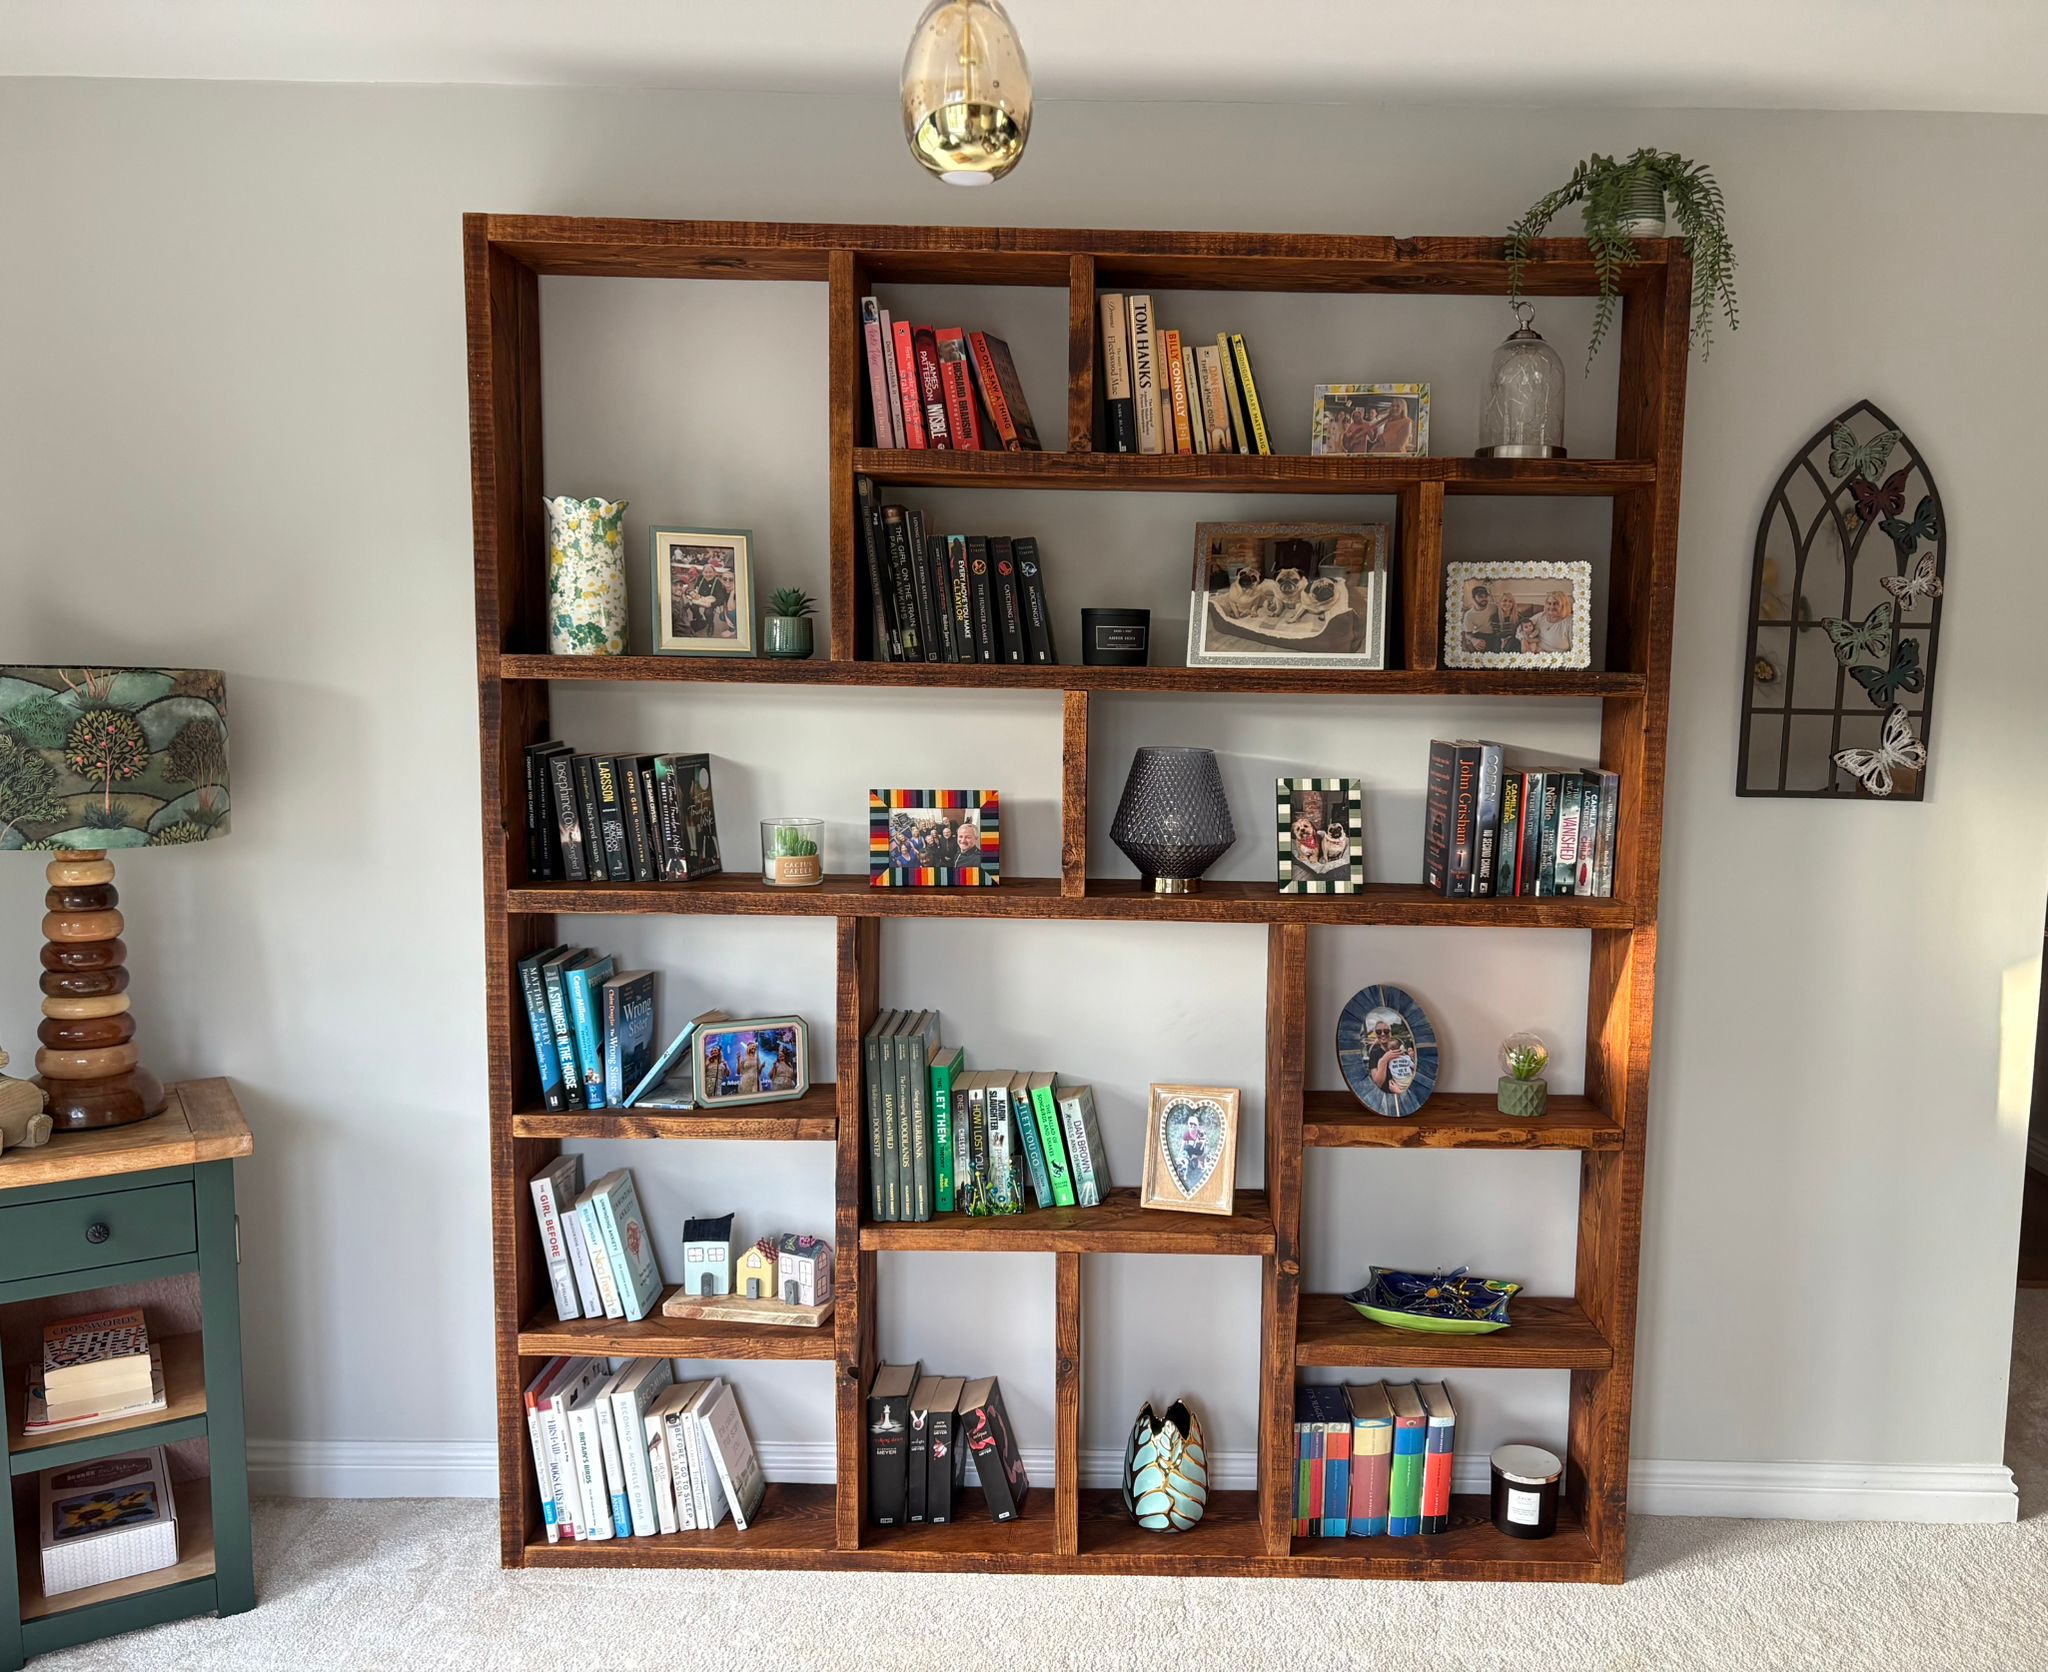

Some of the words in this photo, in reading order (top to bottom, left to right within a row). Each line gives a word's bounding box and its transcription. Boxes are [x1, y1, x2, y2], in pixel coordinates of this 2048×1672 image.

[1135, 304, 1148, 335] TOM
[1107, 336, 1118, 376] Fleetwood
[1169, 334, 1179, 360] BILLY
[920, 351, 934, 401] PATTERSON
[928, 361, 938, 390] JAMES
[1137, 340, 1152, 389] HANKS
[1237, 348, 1250, 383] MIDNIGHT
[900, 370, 909, 392] sarah
[953, 362, 966, 398] RICHARD
[976, 339, 986, 352] NO
[982, 356, 993, 373] ONE
[988, 375, 999, 393] SAW
[996, 404, 1011, 429] THING
[1111, 378, 1120, 395] Mac
[1172, 361, 1185, 416] CONNOLLY
[902, 395, 912, 422] wilson
[1245, 385, 1257, 410] LIBRARY
[926, 404, 947, 438] INVISIBLE
[958, 401, 972, 438] BRANSON
[1206, 409, 1215, 429] CODE
[1252, 414, 1261, 430] MATT
[1256, 432, 1266, 449] HAIG
[895, 526, 904, 543] THE
[889, 536, 900, 568] PAULA
[898, 546, 907, 565] GIRL
[913, 517, 921, 538] LOVING
[918, 566, 927, 584] BYRON
[901, 568, 910, 581] ON
[958, 560, 966, 582] EVERY
[894, 574, 907, 619] HAWKINS
[903, 583, 912, 600] THE
[960, 582, 968, 603] MOVE
[1004, 584, 1013, 618] CATCHING
[906, 602, 916, 627] TRAIN
[1029, 586, 1040, 627] MOCKINGJAY
[963, 619, 971, 639] MAKE
[553, 761, 573, 810] Josephine
[598, 762, 615, 802] LARSSON
[626, 771, 635, 794] GONE
[664, 765, 674, 784] The
[1460, 759, 1474, 789] John
[1485, 755, 1498, 802] COBEN
[668, 782, 676, 803] Time
[1503, 780, 1512, 824] LACKBERG
[1510, 784, 1518, 820] CAMILLA
[1544, 787, 1556, 820] Neville
[630, 797, 638, 815] GIRL
[649, 803, 657, 824] CRYSTAL
[1582, 791, 1591, 831] LACKBERG
[1589, 794, 1597, 828] CAMILLA
[562, 811, 576, 830] Cox
[586, 803, 598, 839] black-eyed
[1456, 793, 1472, 845] Grisham
[1527, 822, 1534, 835] me
[602, 822, 613, 852] TATTOO
[609, 820, 620, 851] DRAGON
[668, 834, 684, 855] Wife
[1481, 838, 1492, 857] SECOND
[1560, 817, 1578, 860] VANISHED
[568, 845, 579, 869] Songbird
[591, 841, 600, 863] susans
[1480, 858, 1491, 878] CHANCE
[573, 976, 582, 998] Cesar
[529, 967, 544, 1014] MATTHEW
[538, 1018, 551, 1046] PERRY
[550, 993, 567, 1035] STRANGER
[576, 999, 586, 1024] Millan
[624, 998, 652, 1022] Wrong
[557, 1036, 568, 1044] IN
[628, 1018, 648, 1037] Sister
[559, 1046, 571, 1060] THE
[608, 1036, 618, 1064] Wrong
[562, 1062, 576, 1089] HOUSE
[610, 1066, 618, 1089] Sister
[885, 1094, 893, 1122] HAVENS
[935, 1090, 945, 1111] LET
[989, 1091, 998, 1131] SLAUGHTER
[973, 1104, 982, 1125] HOW
[1020, 1111, 1030, 1127] LET
[872, 1118, 880, 1158] DOORSTEP
[915, 1110, 923, 1159] RIVERBANK
[937, 1114, 947, 1144] THEM
[974, 1131, 983, 1151] LOST
[1024, 1131, 1036, 1150] YOU
[1073, 1120, 1084, 1139] DAN
[901, 1117, 910, 1168] WOODLANDS
[1070, 1140, 1078, 1153] AND
[1029, 1152, 1039, 1166] GO
[1072, 1154, 1083, 1181] DEMONS
[1077, 1141, 1091, 1174] BROWN
[539, 1194, 550, 1217] GIRL
[545, 1219, 560, 1258] BEFORE
[582, 1208, 591, 1222] BLUE
[586, 1223, 597, 1246] MONDAY
[607, 1230, 618, 1251] ANXIETY
[52, 1316, 136, 1335] CROSSWORDS
[638, 1366, 672, 1409] BECOMING
[600, 1410, 608, 1425] THE
[578, 1431, 589, 1463] BRITAIN'S
[674, 1428, 685, 1459] BEFORE
[620, 1401, 633, 1442] BECOMING
[628, 1452, 640, 1489] MICHELLE
[634, 1492, 644, 1520] OBAMA
[671, 1451, 678, 1462] SJ
[552, 1462, 562, 1482] DOGS
[583, 1464, 592, 1484] BIRDS
[673, 1464, 683, 1497] WATSON
[680, 1466, 687, 1478] GO
[554, 1483, 564, 1502] CATS
[681, 1480, 689, 1490] TO
[612, 1498, 621, 1524] ANXIETY
[683, 1492, 693, 1518] SLEEP
